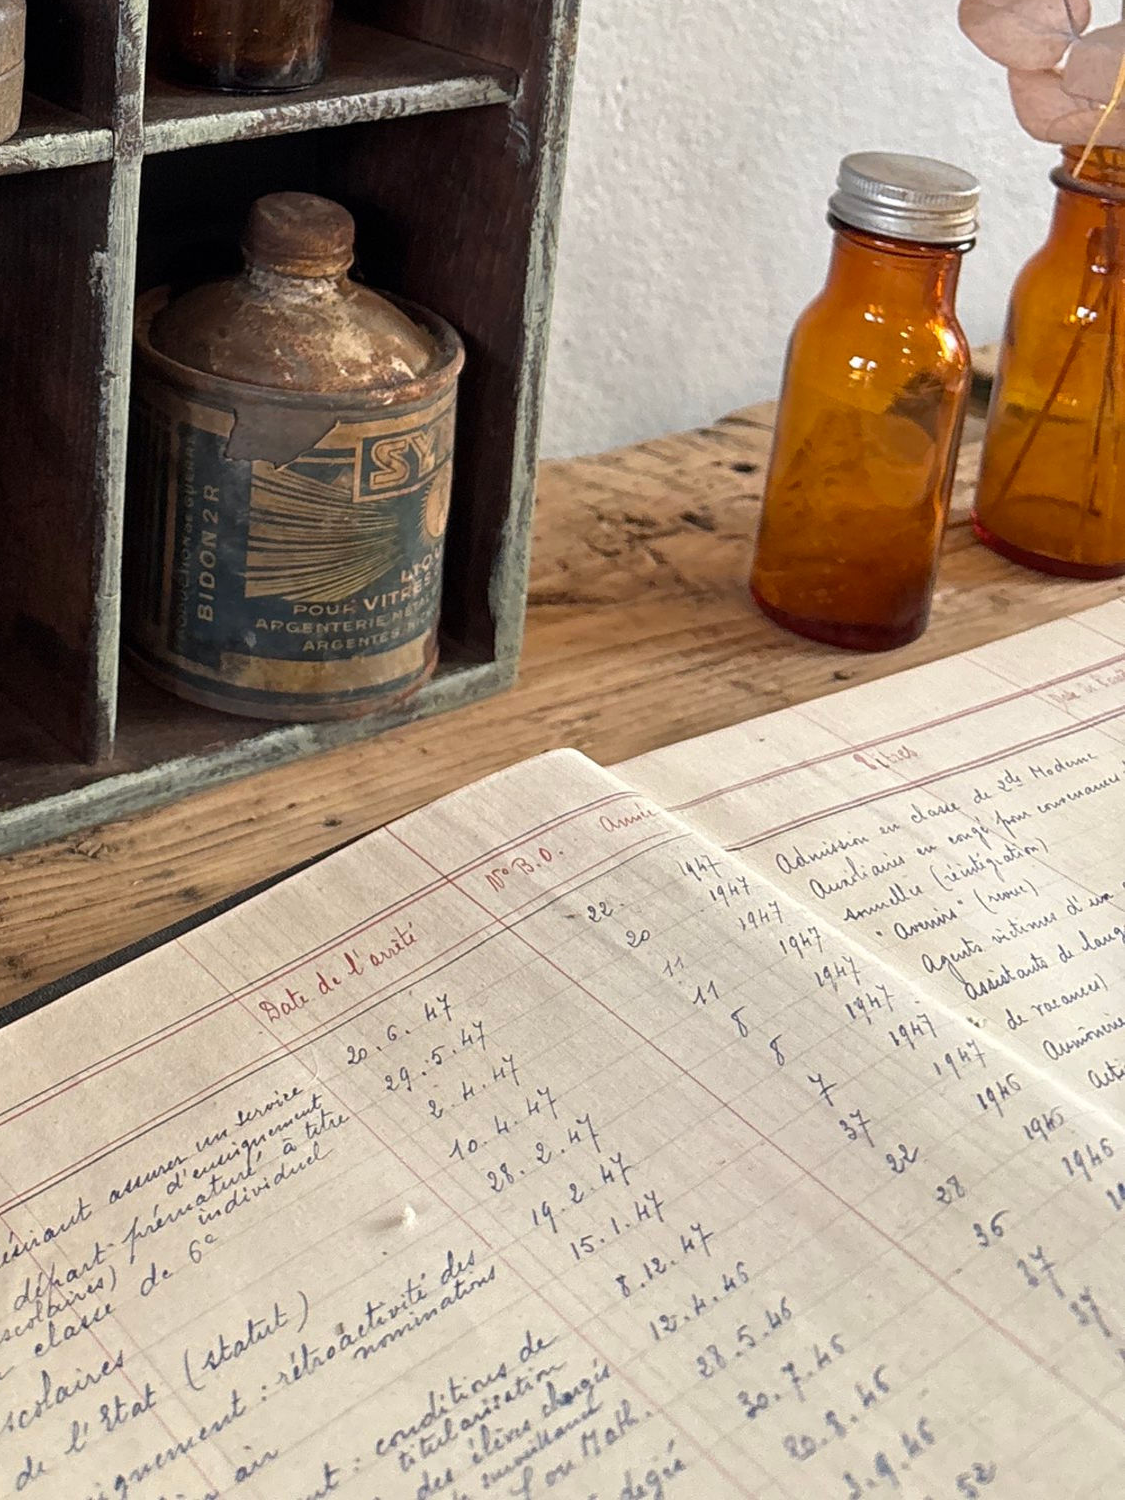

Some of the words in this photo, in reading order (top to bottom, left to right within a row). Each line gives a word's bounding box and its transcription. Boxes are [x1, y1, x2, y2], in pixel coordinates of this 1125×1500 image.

[202, 509, 219, 525] 2
[197, 530, 218, 621] BIDON
[776, 834, 870, 875] Admission
[880, 821, 900, 836] en
[911, 802, 961, 824] classe
[973, 788, 993, 805] de
[1028, 752, 1098, 779] Moderne
[677, 854, 724, 882] 1947
[809, 853, 906, 900] Auxiliaires
[916, 843, 938, 857] en
[948, 815, 993, 851] congé
[994, 809, 1033, 840] pour
[709, 876, 753, 907] 1947
[973, 878, 1039, 915] (revue)
[738, 900, 785, 932] 1947
[625, 929, 651, 948] 20
[779, 926, 824, 959] 1947
[921, 936, 984, 987] Agents
[991, 911, 1058, 945] victimes
[814, 955, 861, 992] 1947
[964, 952, 1049, 1001] Assistants
[1057, 943, 1075, 964] de
[259, 988, 309, 1024] Date
[316, 971, 342, 995] de
[692, 980, 720, 1005] 11
[845, 983, 895, 1025] 1947
[730, 1005, 749, 1038] 8
[888, 1012, 938, 1050] 1947
[1005, 1008, 1029, 1031] de
[769, 1034, 786, 1067] 8
[933, 1039, 987, 1081] 1947
[806, 1072, 838, 1107] 7
[304, 1108, 351, 1140] titre
[108, 1155, 188, 1205] assurer
[196, 1128, 229, 1153] un
[234, 1086, 304, 1128] service
[885, 1143, 919, 1175] 22
[198, 1141, 335, 1227] individuel
[34, 1303, 116, 1357] classe
[141, 1261, 174, 1297] de
[275, 1271, 428, 1387] rétroactivité
[440, 1250, 476, 1286] des
[353, 1264, 497, 1361] nominations
[375, 1361, 508, 1456] conditions
[519, 1329, 561, 1364] de
[16, 1455, 47, 1492] de
